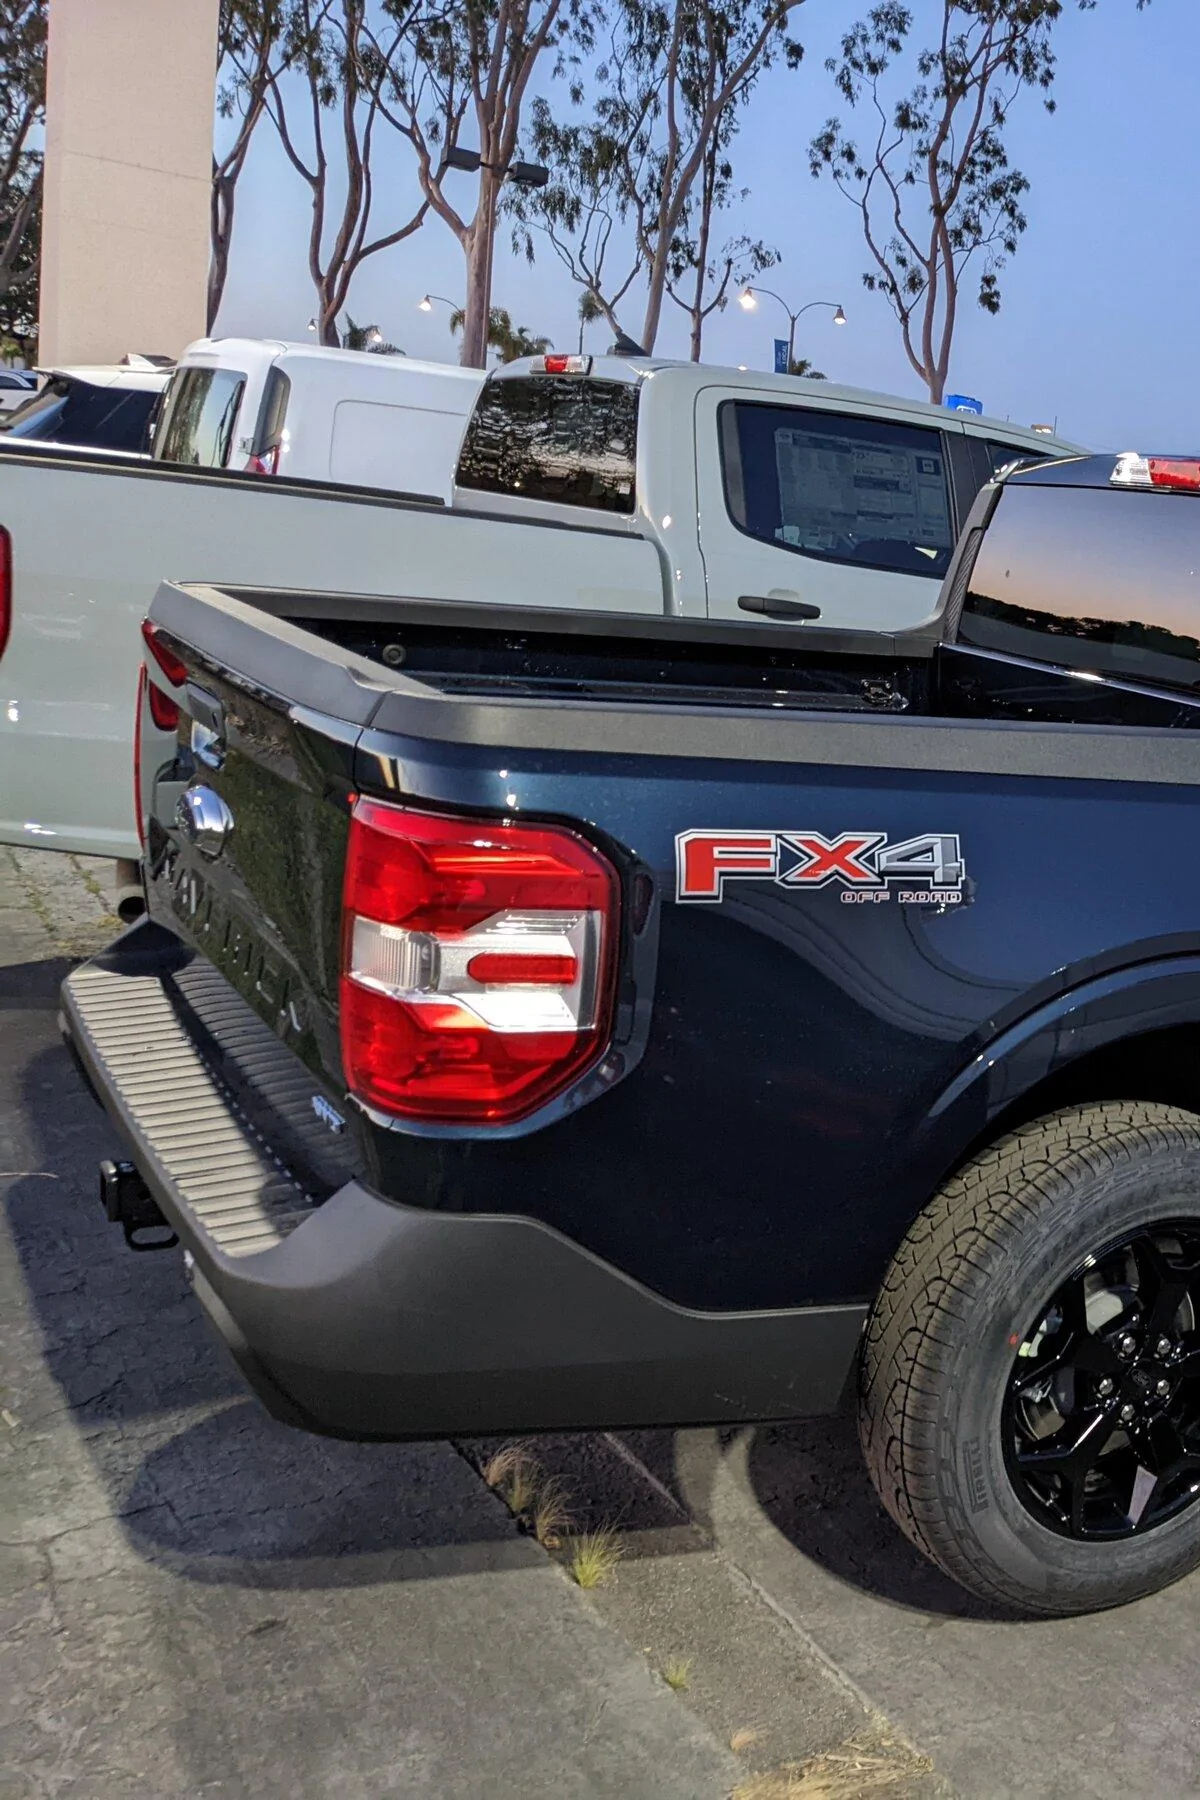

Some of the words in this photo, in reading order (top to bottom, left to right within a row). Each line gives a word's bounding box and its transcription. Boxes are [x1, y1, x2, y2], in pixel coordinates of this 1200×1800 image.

[675, 829, 965, 904] FX4
[840, 891, 890, 903] OFF
[898, 891, 962, 903] ROAD
